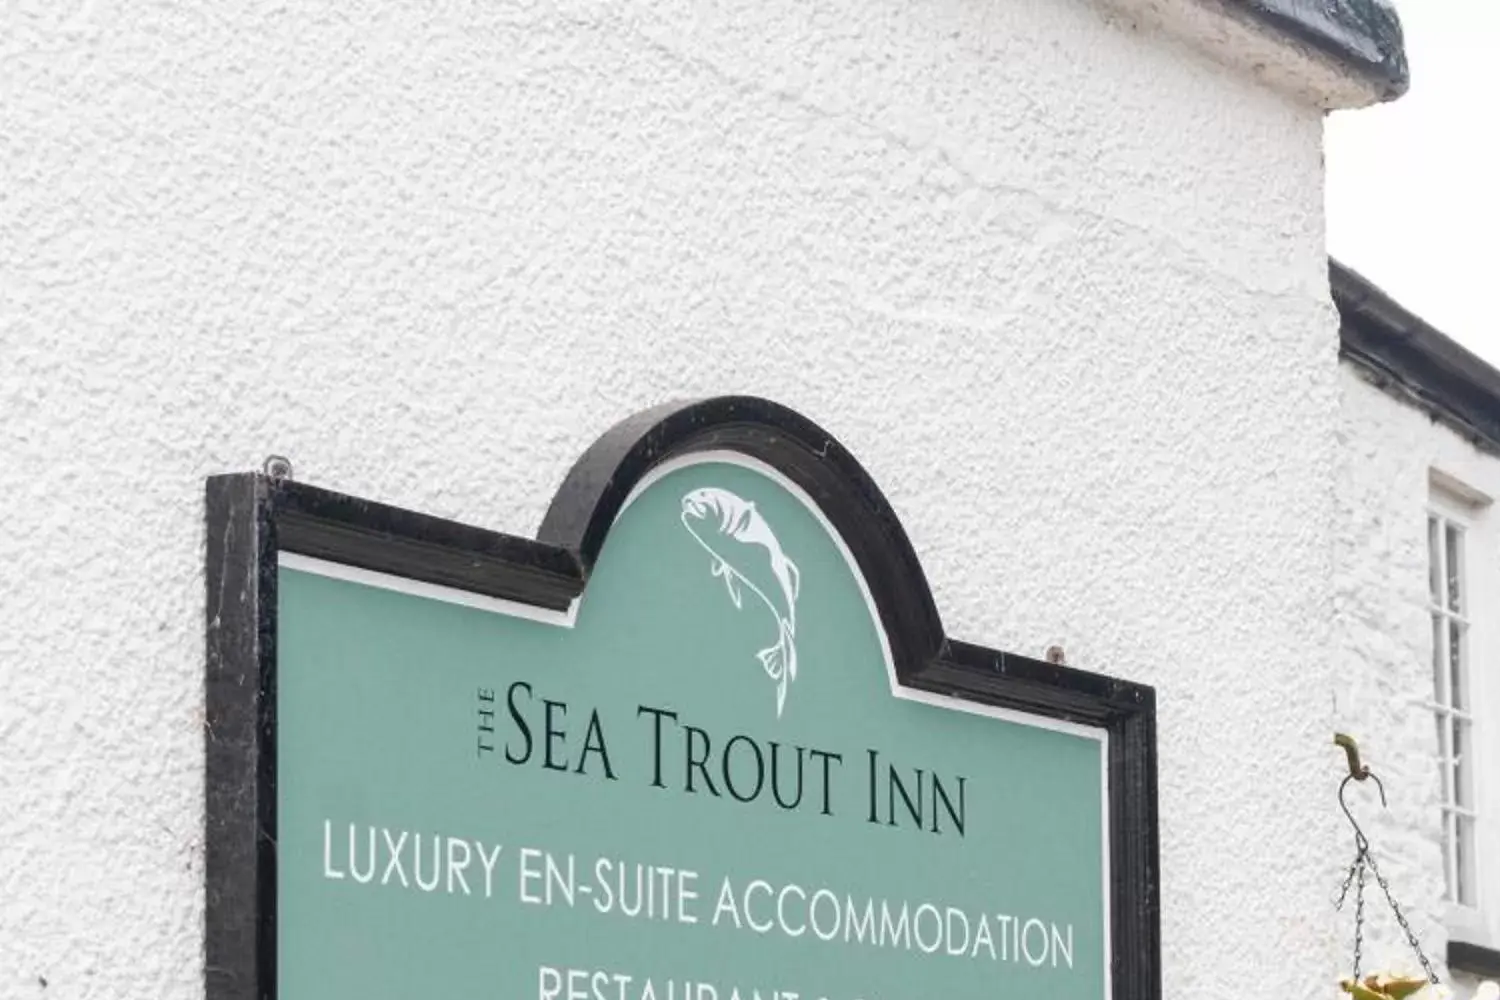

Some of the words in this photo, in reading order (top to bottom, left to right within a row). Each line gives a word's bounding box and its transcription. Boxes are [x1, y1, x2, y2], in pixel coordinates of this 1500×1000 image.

[477, 686, 496, 756] THE
[503, 681, 617, 780] SEA
[637, 705, 843, 816] TROUT
[866, 749, 968, 838] INN
[323, 819, 501, 897] LUXURY
[521, 847, 698, 923] EN-SUITE
[712, 876, 1073, 968] ACCOMMODATION
